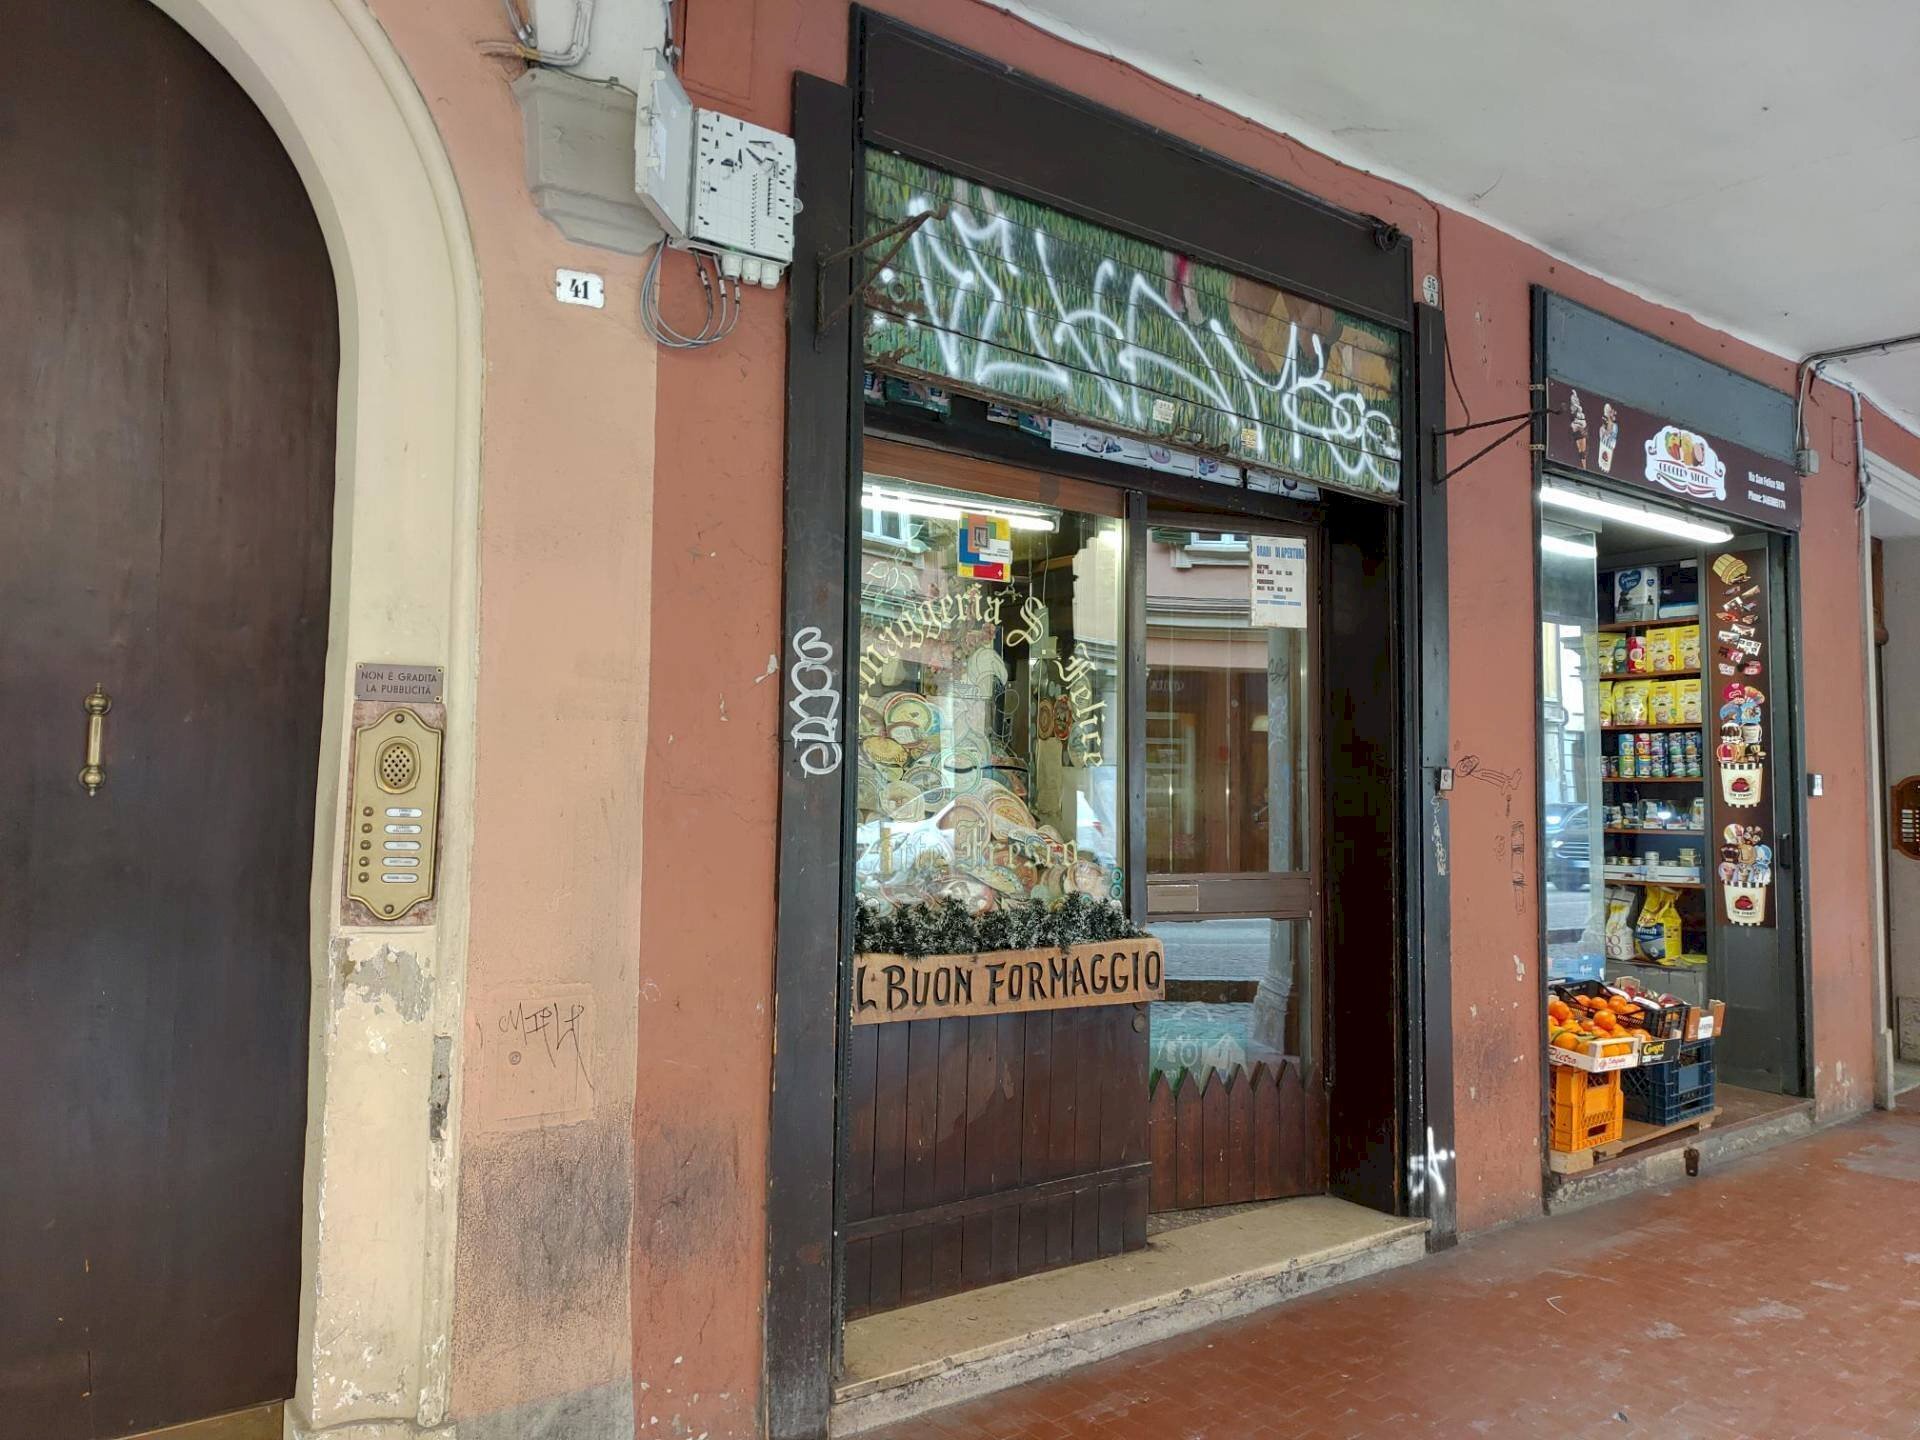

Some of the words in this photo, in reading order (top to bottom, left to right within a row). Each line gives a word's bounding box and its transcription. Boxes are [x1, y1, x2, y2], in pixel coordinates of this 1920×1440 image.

[570, 279, 589, 300] 41
[361, 671, 384, 680] NON
[398, 672, 437, 683] GRADITA
[859, 583, 1005, 706] maggeria
[1052, 642, 1108, 768] Felice
[366, 683, 376, 693] LA
[856, 964, 877, 1013] L
[881, 964, 972, 1013] BUON
[985, 950, 1161, 1006] FORMAGGIO
